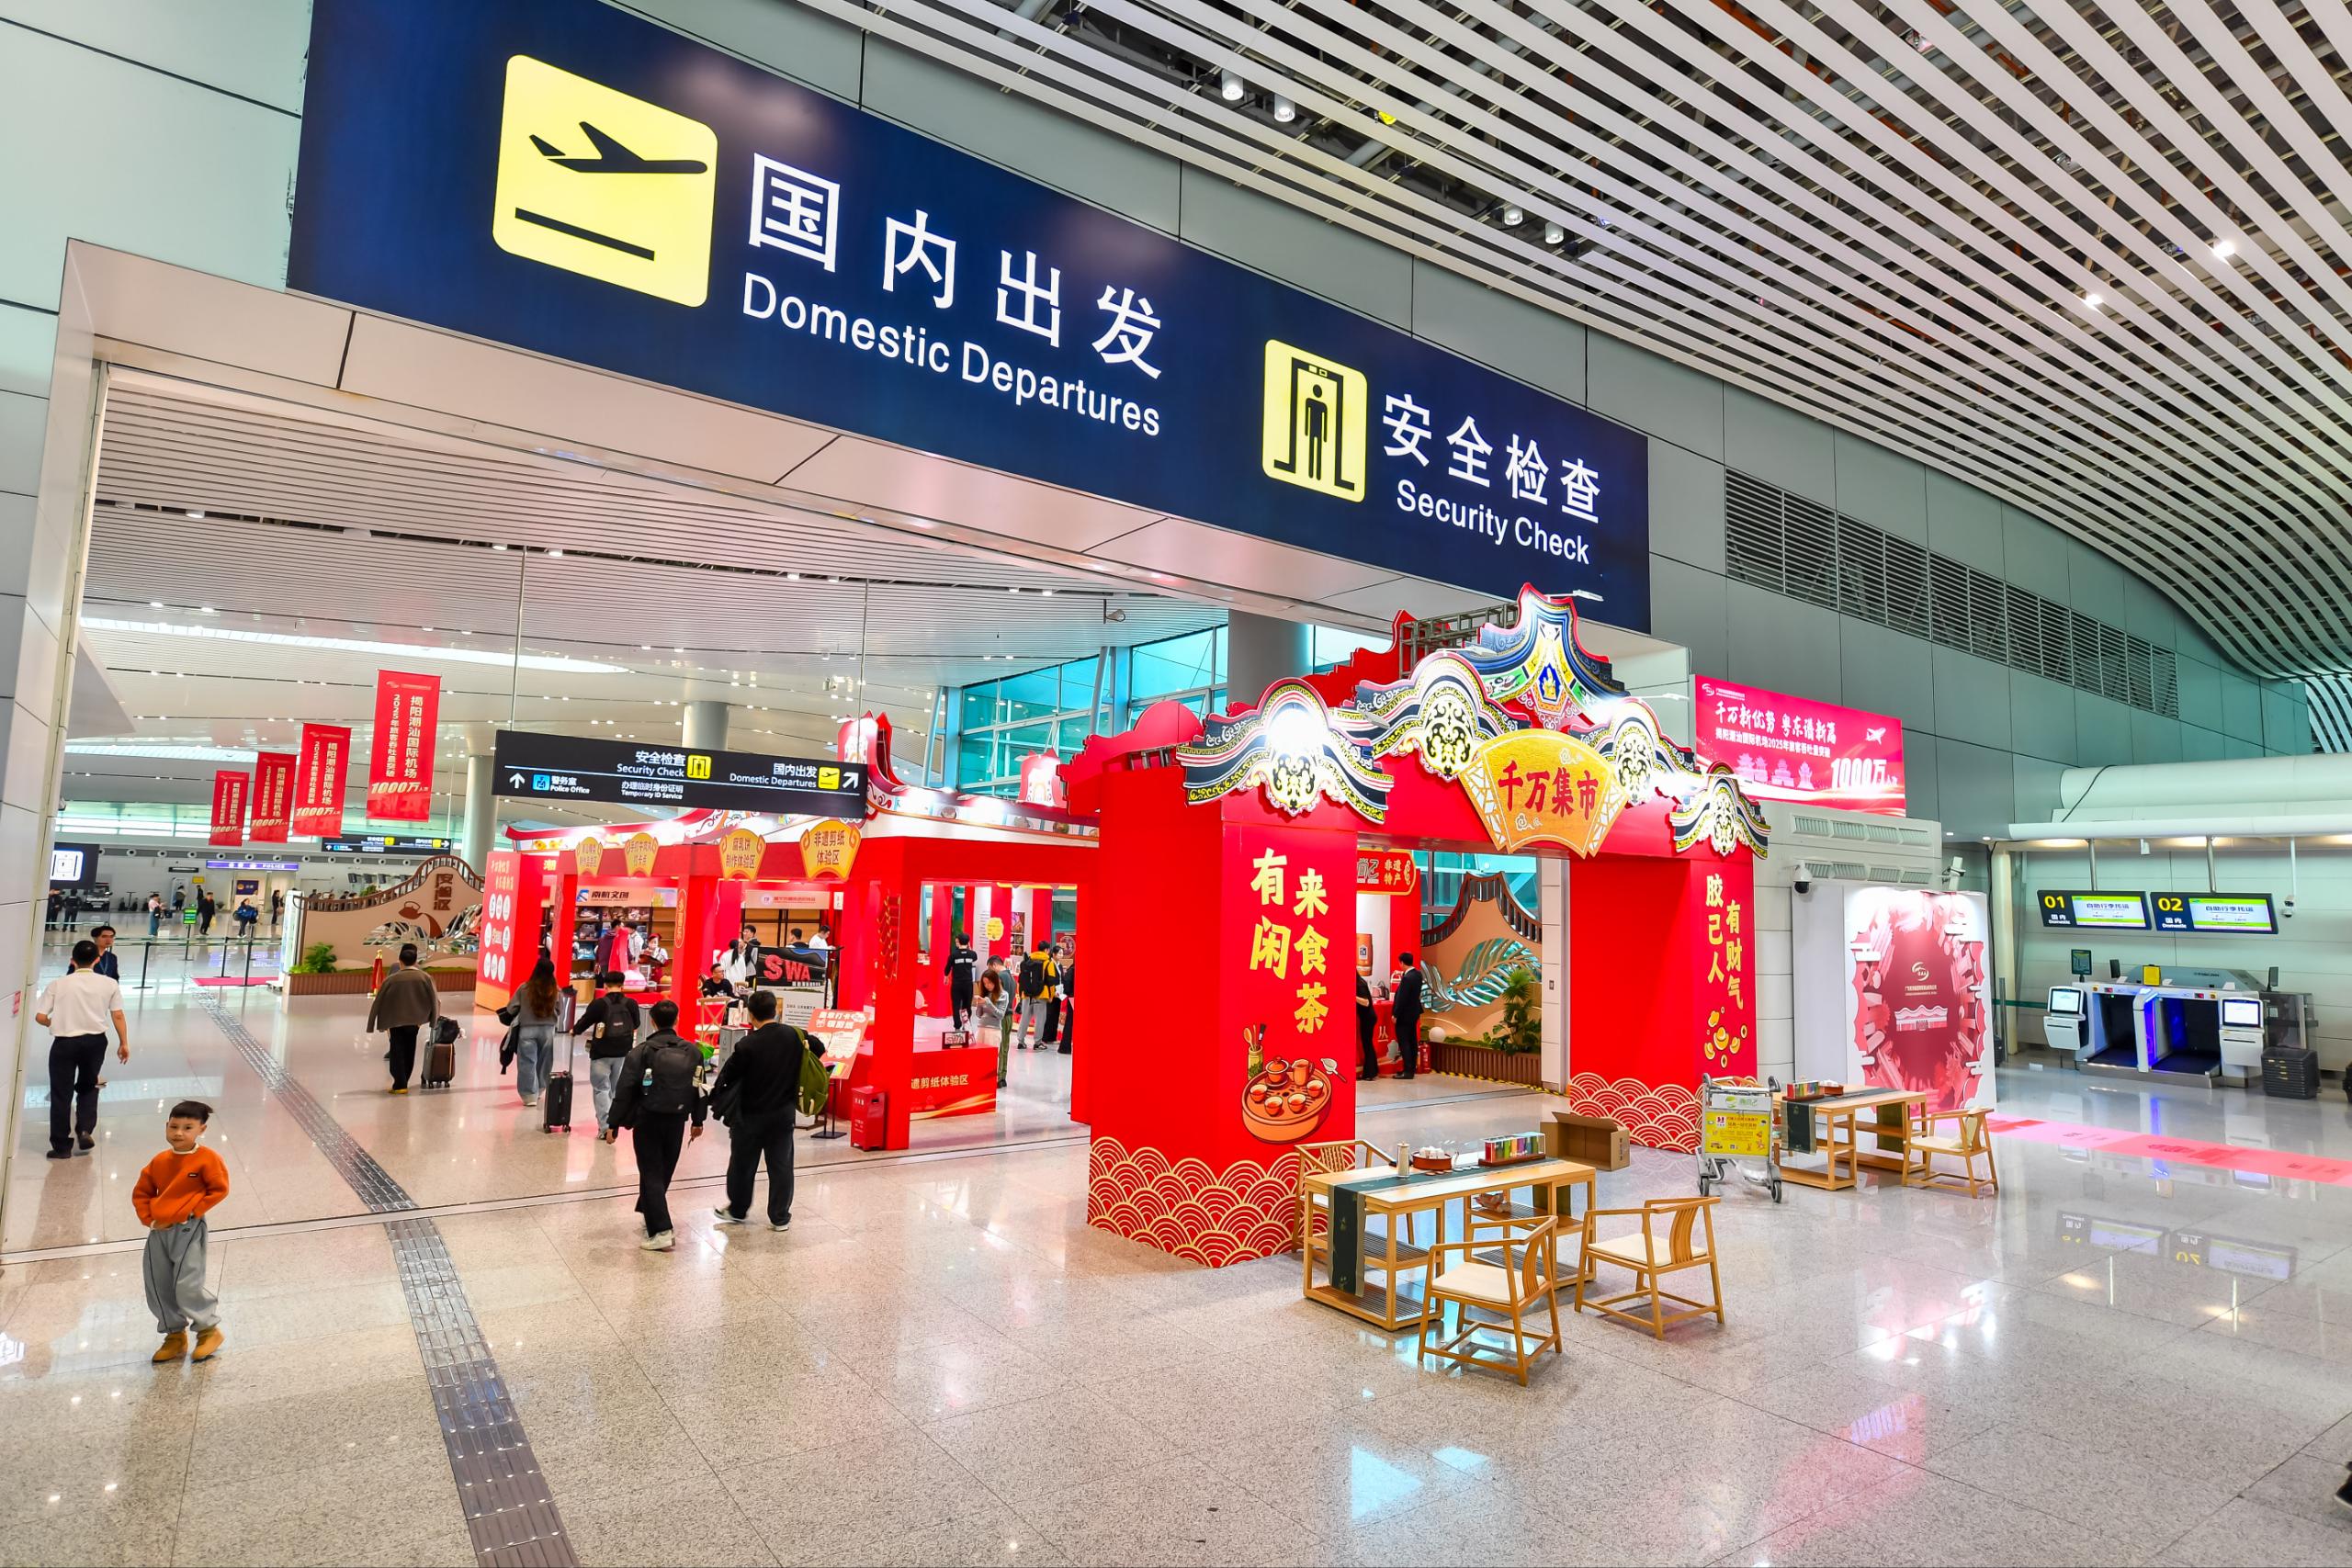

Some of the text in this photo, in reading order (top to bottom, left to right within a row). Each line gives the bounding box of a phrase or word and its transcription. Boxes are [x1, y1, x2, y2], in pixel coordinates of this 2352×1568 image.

[748, 152, 1162, 379] 国内出发
[742, 271, 1160, 437] Domestic Departures
[1382, 393, 1600, 524] 安全检查
[1396, 479, 1589, 565] Security Check
[1714, 700, 1776, 734] 千万新优势
[404, 695, 424, 779] 揭阳潮汕国际机场
[616, 763, 684, 778] Security Check
[635, 750, 685, 767] 安全检查
[773, 762, 818, 778] 国内出发
[549, 784, 570, 793] Police
[621, 789, 653, 799] Temporary
[662, 792, 683, 800] Service
[729, 773, 817, 788] Domestic Departures
[1498, 759, 1599, 820] 千万集市
[814, 829, 845, 847] 非遗剪纸
[817, 850, 840, 865] 体验区
[1250, 847, 1292, 980] 有闲
[2044, 896, 2065, 908] 01
[2157, 897, 2184, 911] 02
[1705, 873, 1725, 984] 胶己人
[1293, 867, 1329, 1034] 来食茶
[1725, 898, 1744, 1010] 有财气
[763, 953, 811, 982] SWA
